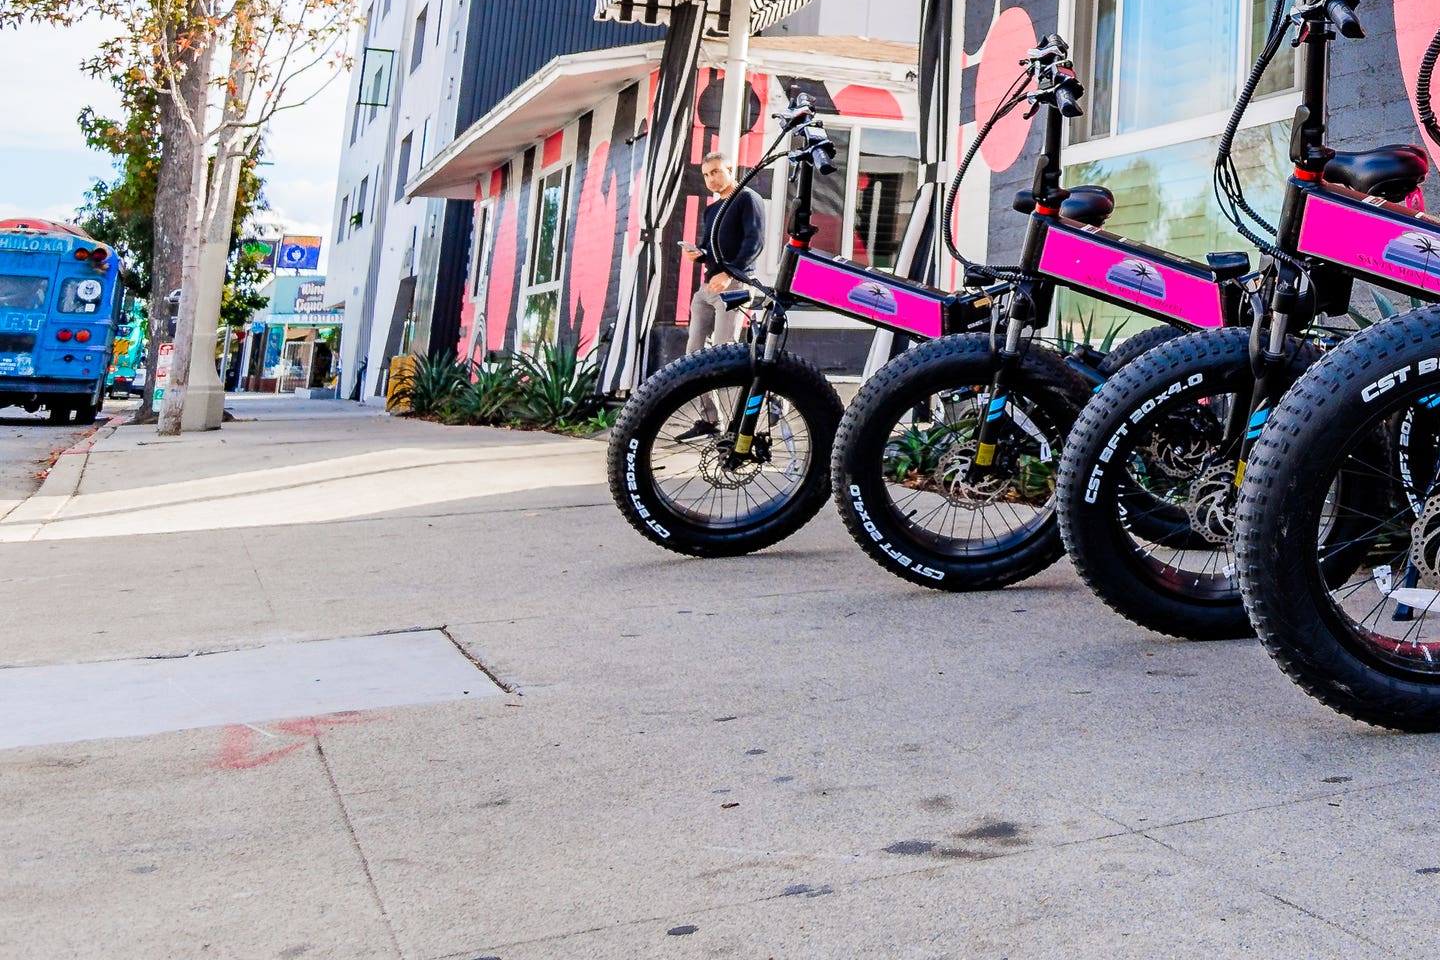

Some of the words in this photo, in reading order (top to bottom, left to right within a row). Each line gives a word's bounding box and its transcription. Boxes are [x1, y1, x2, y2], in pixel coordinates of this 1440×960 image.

[1360, 365, 1412, 404] CST
[1084, 463, 1105, 504] CST
[1099, 422, 1129, 464] BFT
[630, 492, 651, 519] BFT
[645, 518, 671, 539] CST
[879, 542, 913, 567] BFT
[910, 563, 946, 581] CST
